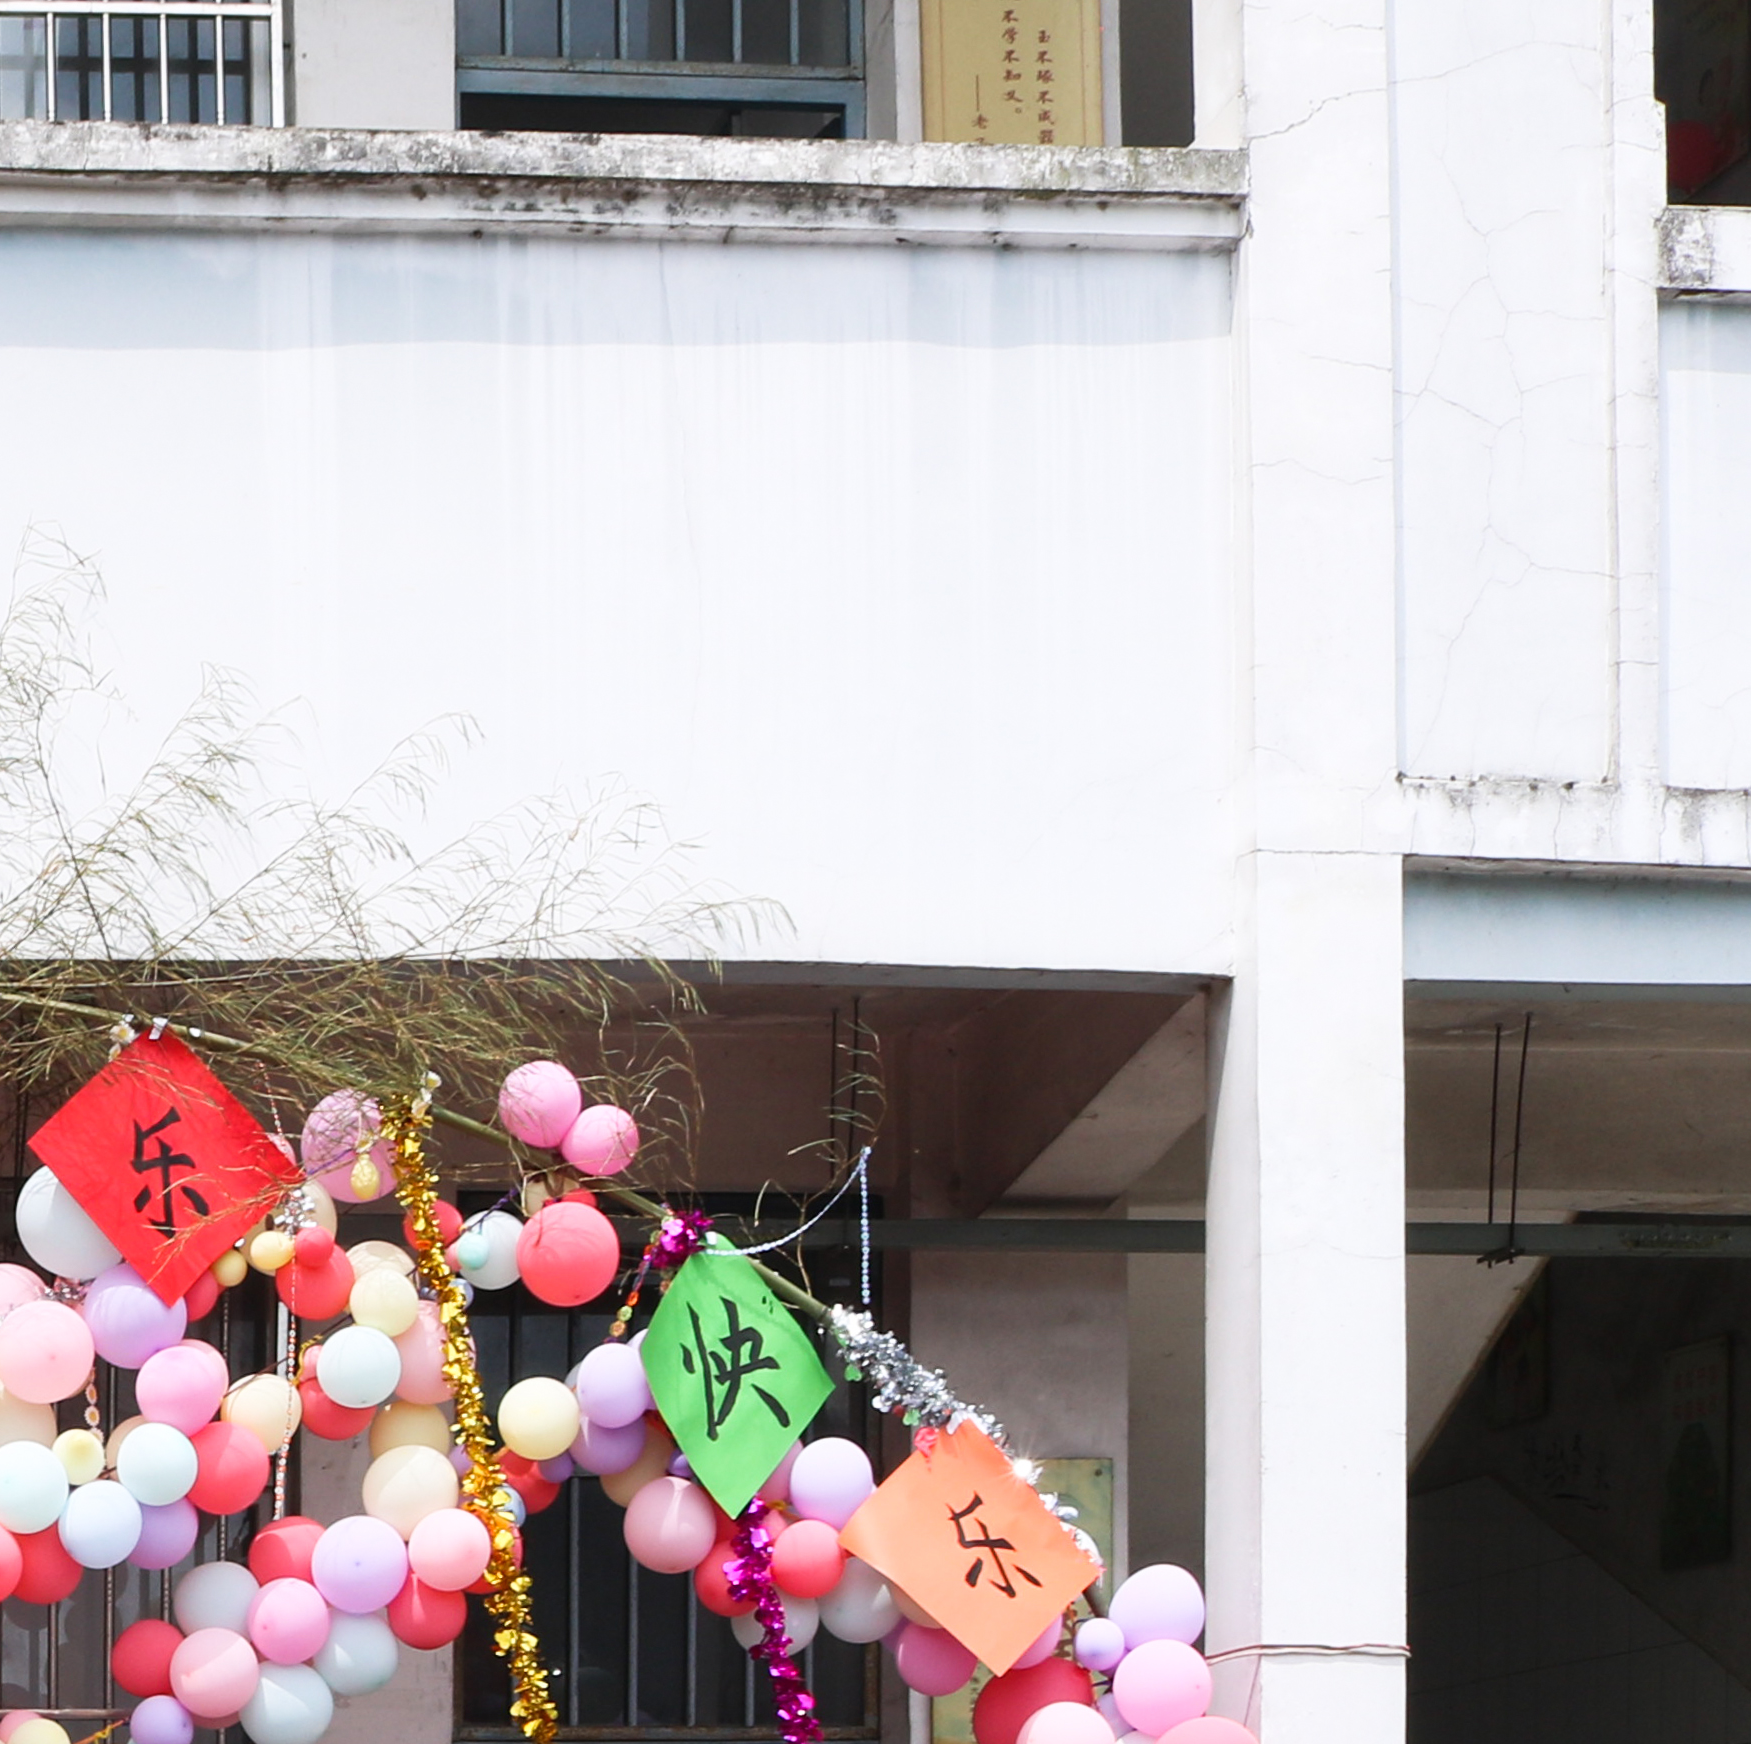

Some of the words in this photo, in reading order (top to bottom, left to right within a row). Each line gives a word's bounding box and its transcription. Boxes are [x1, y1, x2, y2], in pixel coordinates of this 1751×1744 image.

[132, 1106, 211, 1239] 乐
[682, 1295, 791, 1442] 快
[947, 1492, 1043, 1599] 乐
